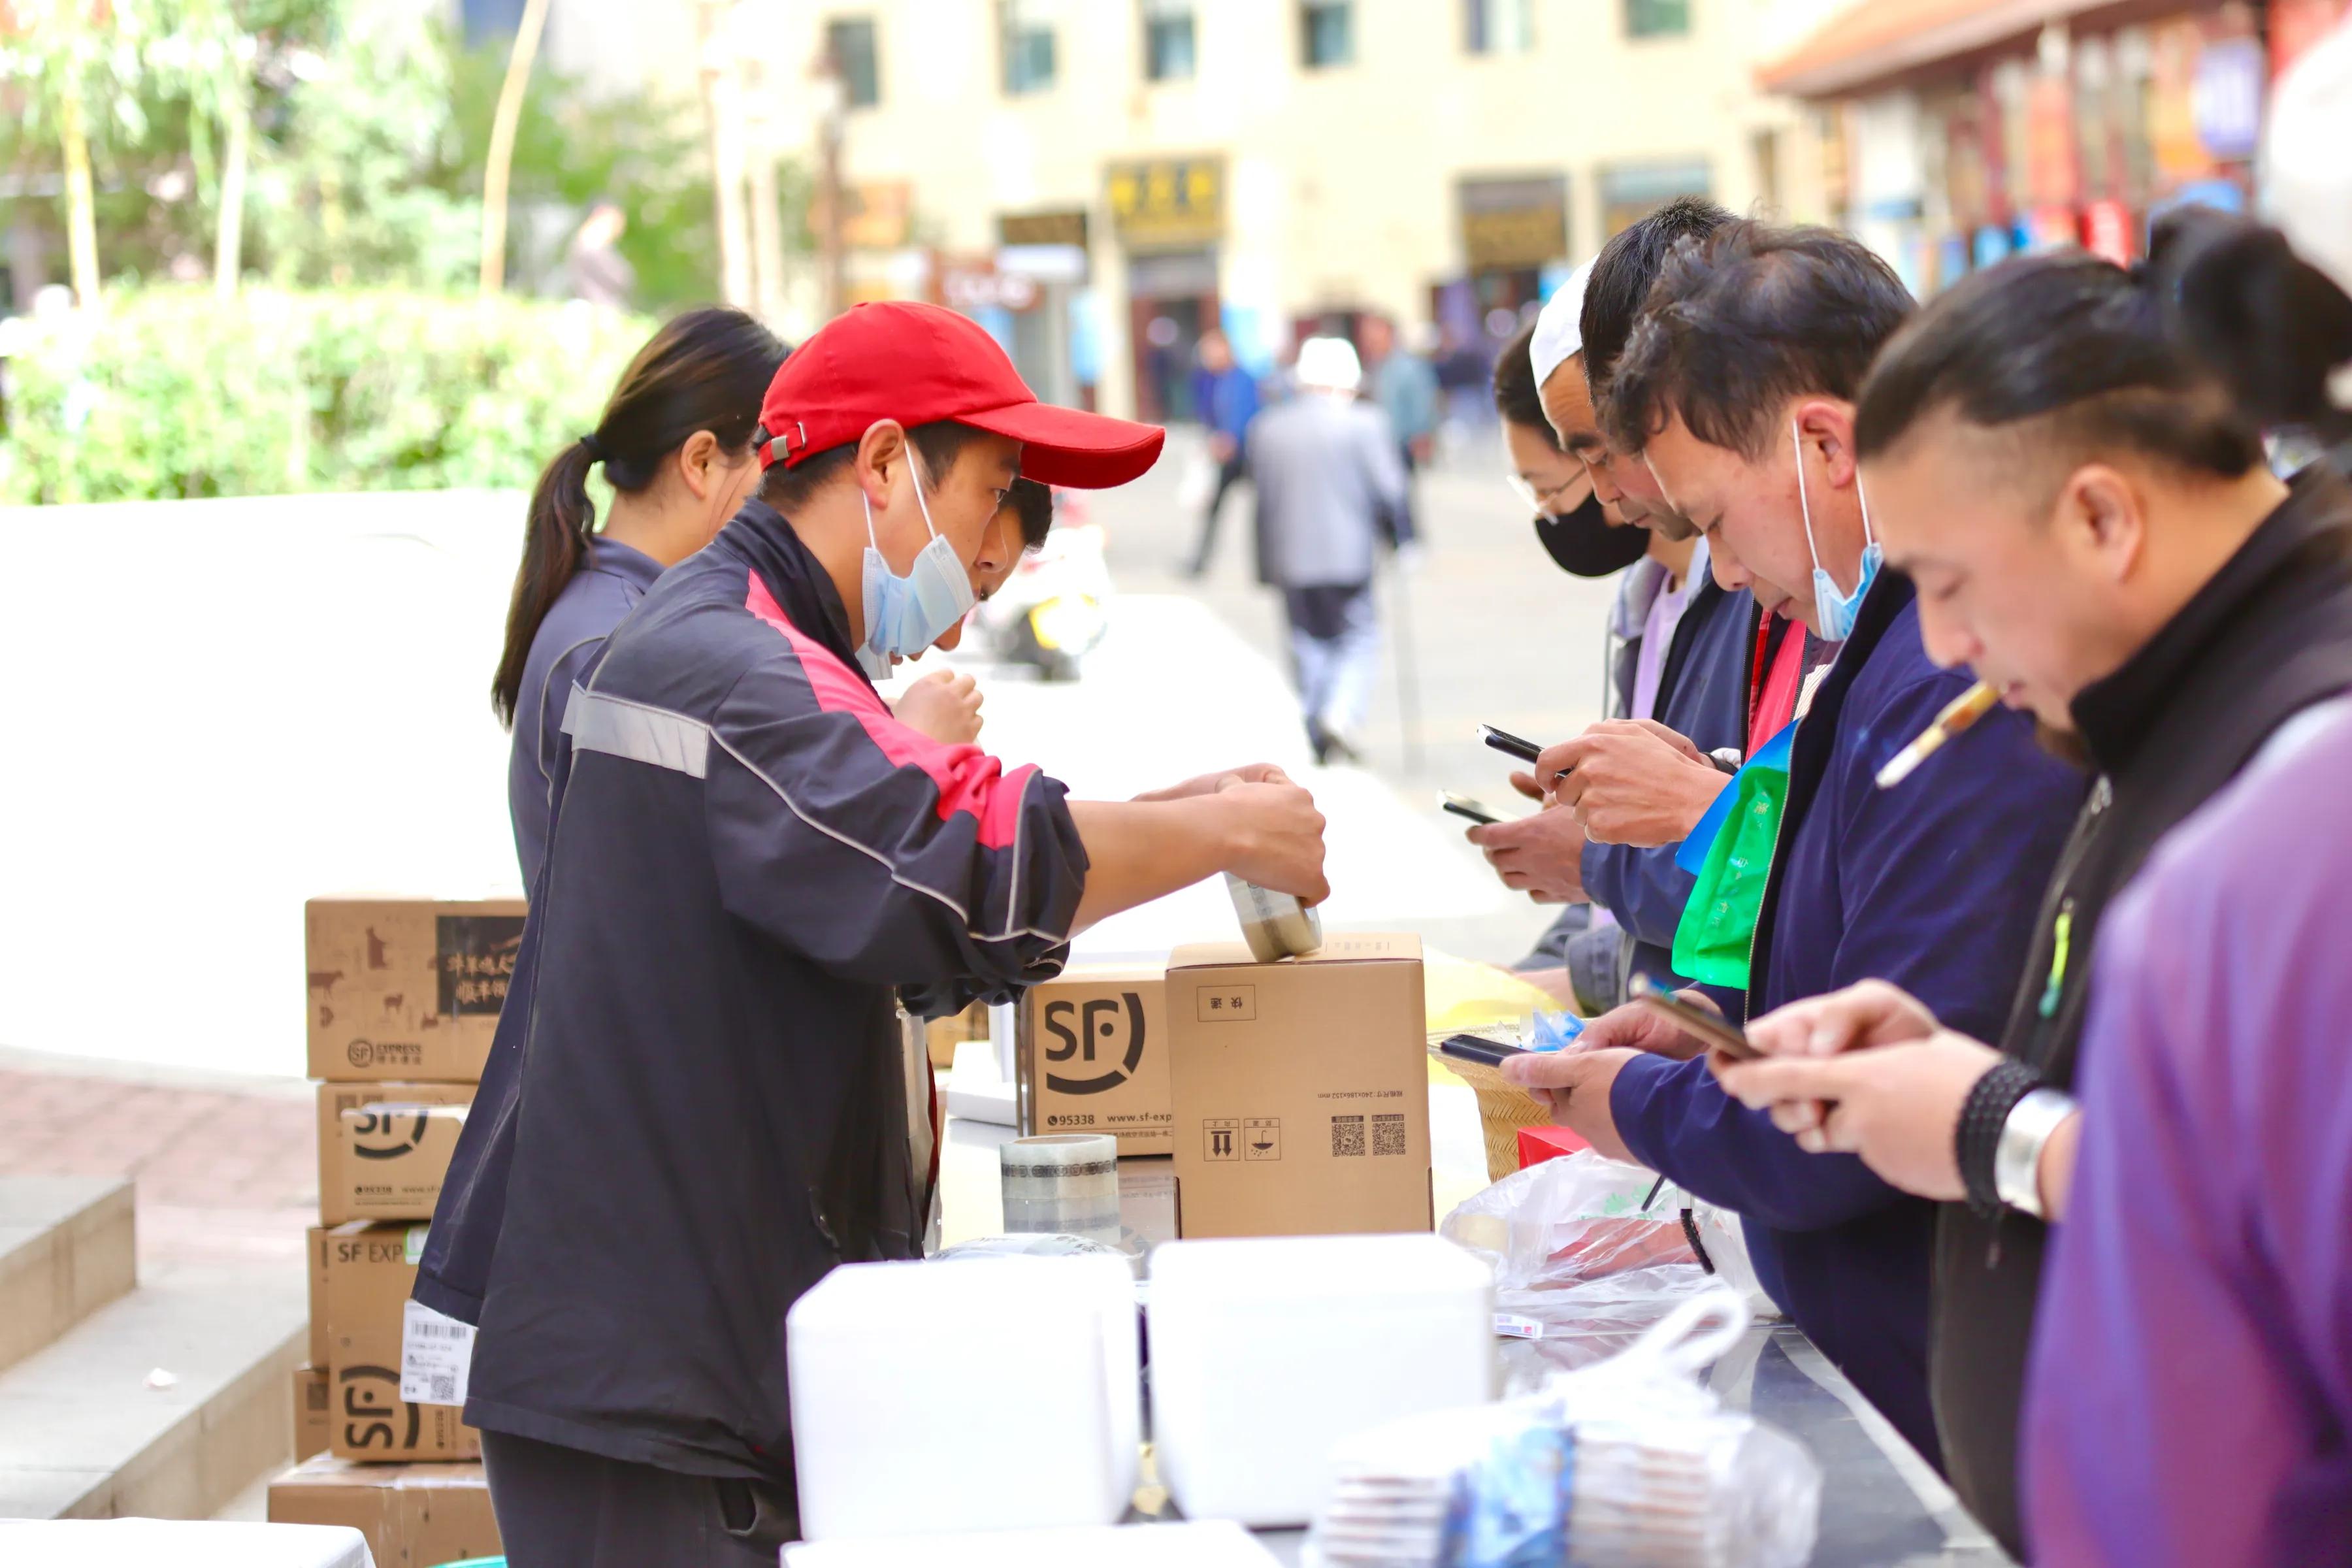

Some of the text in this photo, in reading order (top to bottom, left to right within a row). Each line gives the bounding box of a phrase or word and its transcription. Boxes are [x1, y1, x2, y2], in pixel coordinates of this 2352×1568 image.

[1210, 996, 1243, 1009] 快递
[1045, 999, 1119, 1062] SF
[1058, 1112, 1172, 1125] 95338 www.sf-exp
[338, 1243, 403, 1263] SF EXP
[344, 1385, 394, 1449] SF
